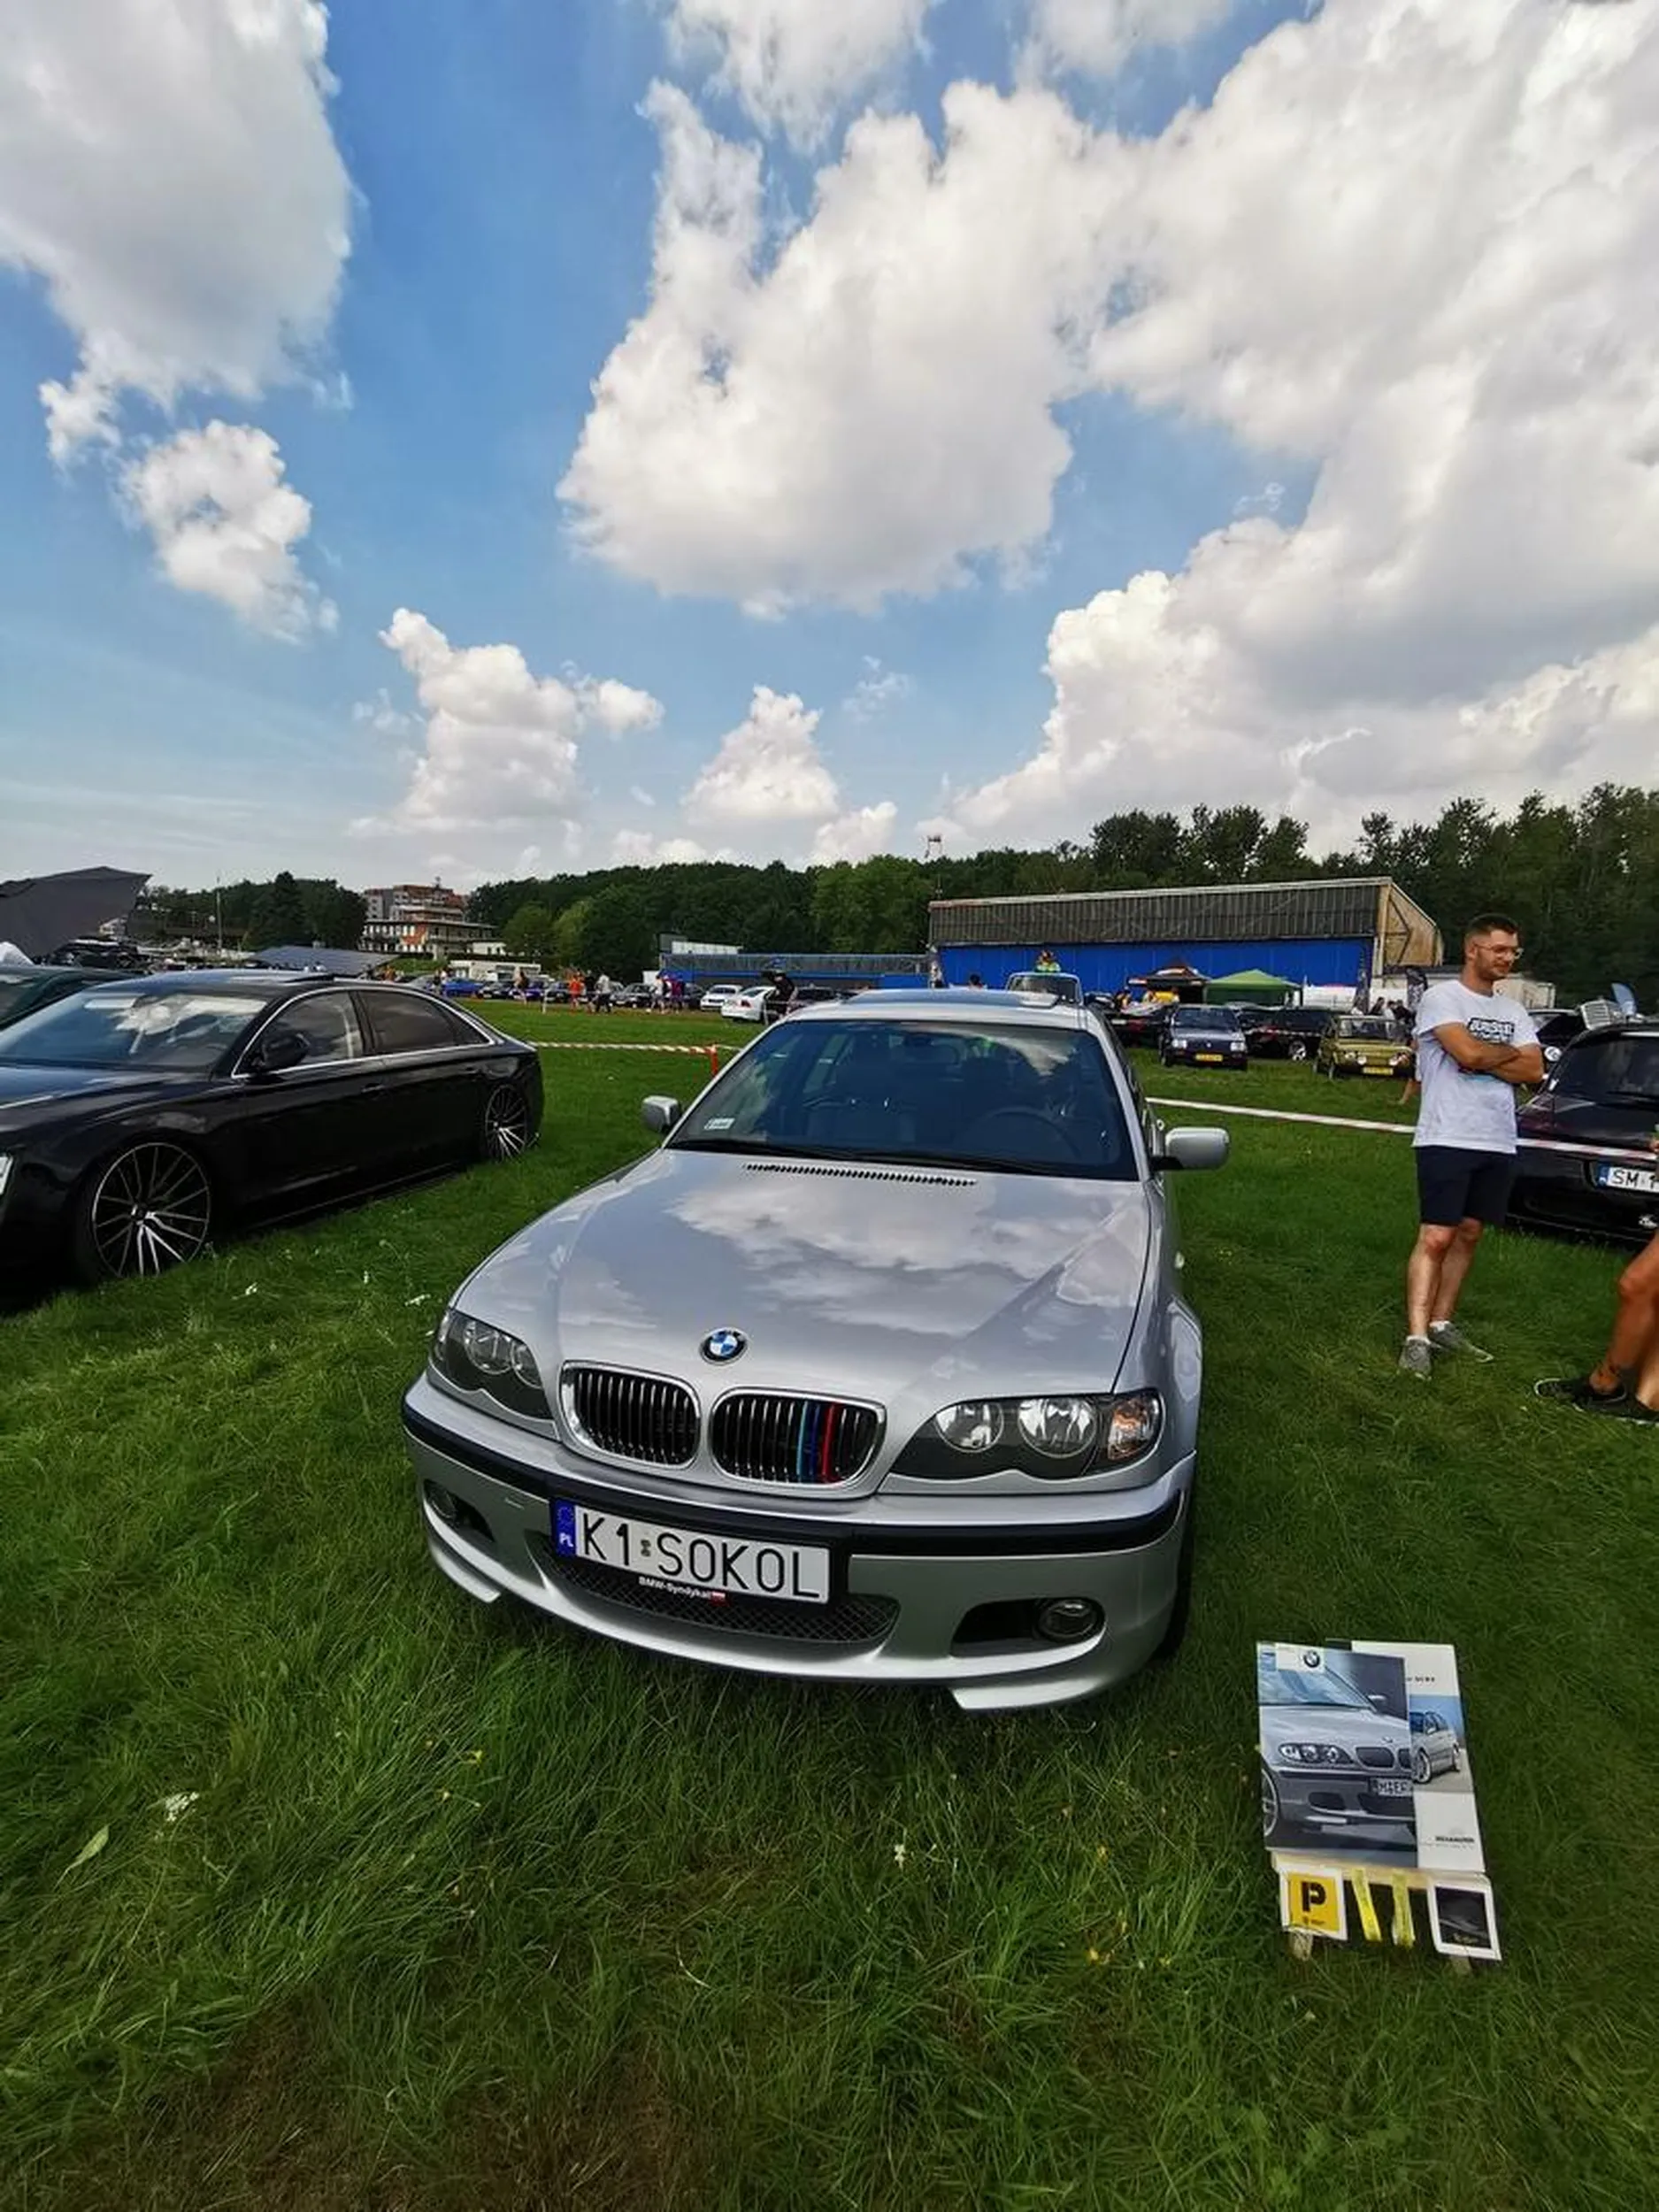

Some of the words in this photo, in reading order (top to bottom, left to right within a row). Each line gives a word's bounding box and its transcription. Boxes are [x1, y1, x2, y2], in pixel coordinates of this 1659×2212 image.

[1611, 1169, 1640, 1187] SM
[559, 1532, 574, 1548] PL
[583, 1512, 630, 1566] K1
[657, 1532, 819, 1598] SOKOL
[1301, 1881, 1326, 1913] P
